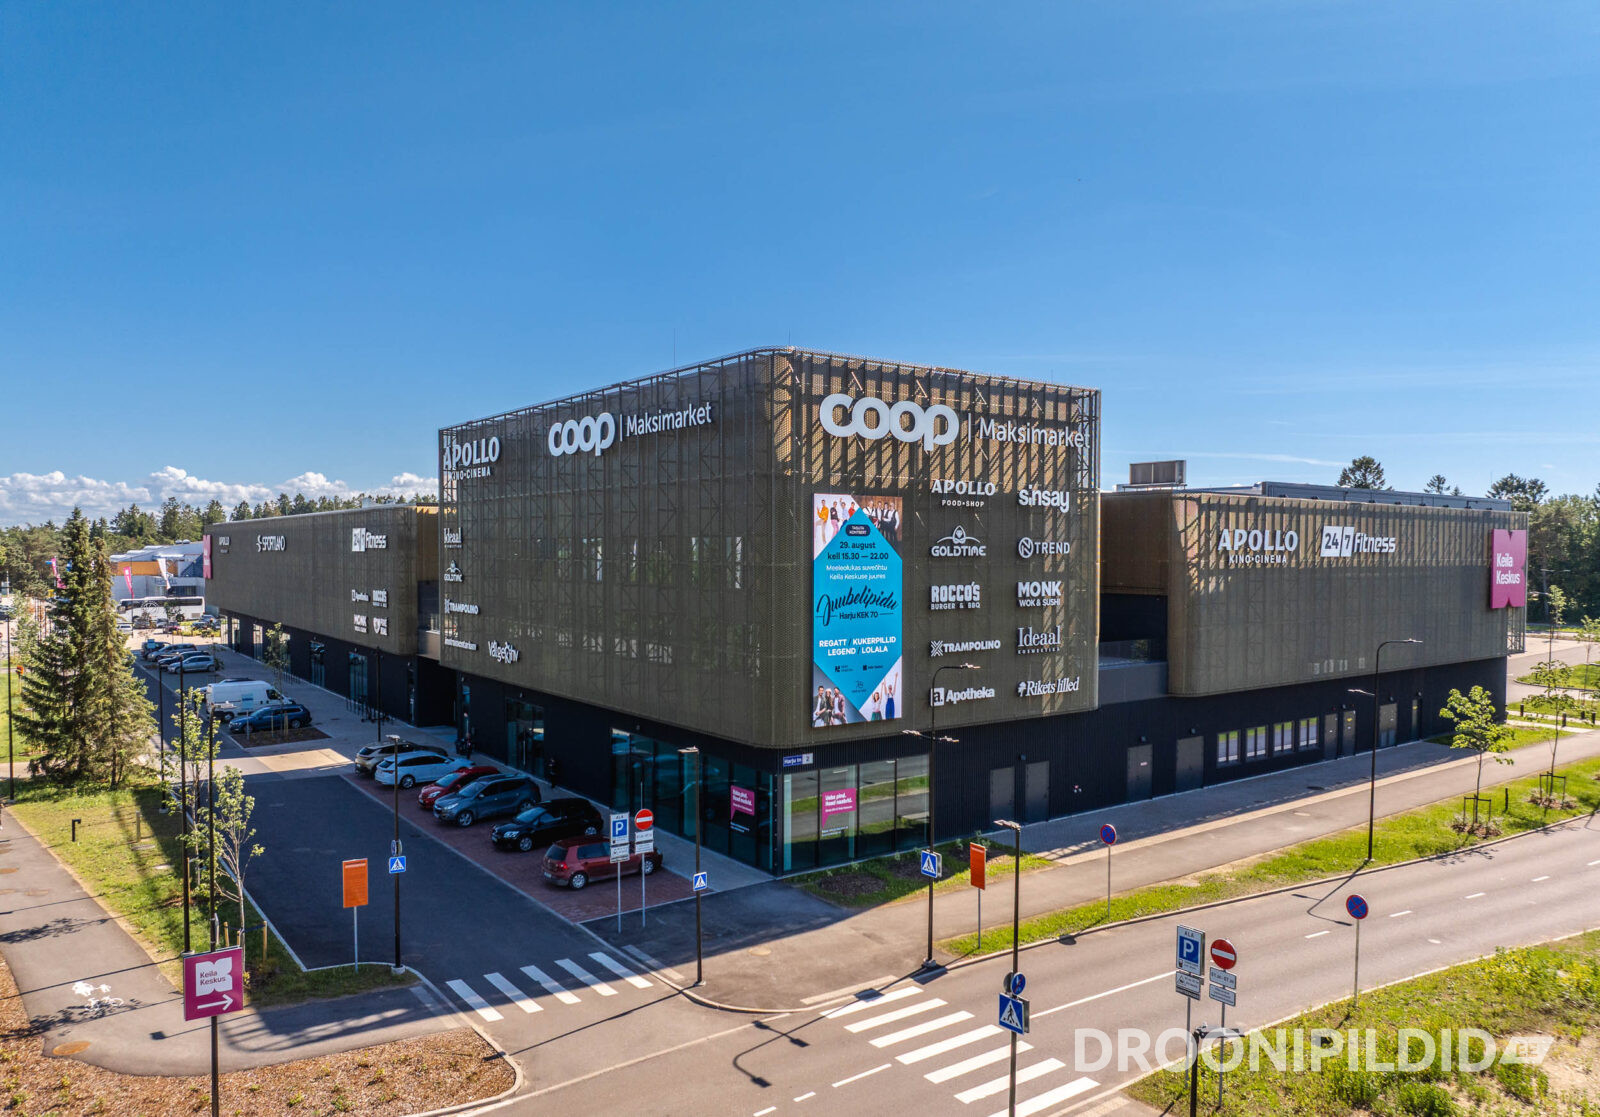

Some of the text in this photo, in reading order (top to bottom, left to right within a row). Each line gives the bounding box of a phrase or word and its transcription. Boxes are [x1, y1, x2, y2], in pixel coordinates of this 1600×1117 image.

[548, 402, 712, 456] coop Maksimarket
[819, 393, 1090, 450] coop Maksimarket
[443, 436, 500, 470] APOLLO
[931, 480, 996, 496] APOLLO
[1018, 485, 1070, 513] sinsay
[852, 542, 876, 550] august
[1035, 542, 1070, 554] TREND
[1218, 528, 1298, 552] APOLLO
[931, 545, 986, 557] GOLDTIME
[1496, 552, 1513, 568] Keila
[1496, 570, 1520, 585] Keskus
[1017, 581, 1061, 598] MONK
[816, 585, 897, 626] Juubelipidu
[819, 639, 847, 647] REGATT
[853, 636, 896, 645] KUKERPILLID
[1018, 625, 1060, 647] Ideaal
[828, 648, 856, 656] LEGEND
[862, 646, 888, 654] LOLALA
[943, 640, 1001, 652] TRAMPOLINO
[946, 686, 995, 704] Apotheka
[1025, 680, 1056, 696] Rikets
[616, 821, 624, 835] P
[1183, 940, 1194, 958] P
[200, 970, 218, 979] Keila
[200, 976, 226, 986] Keskus
